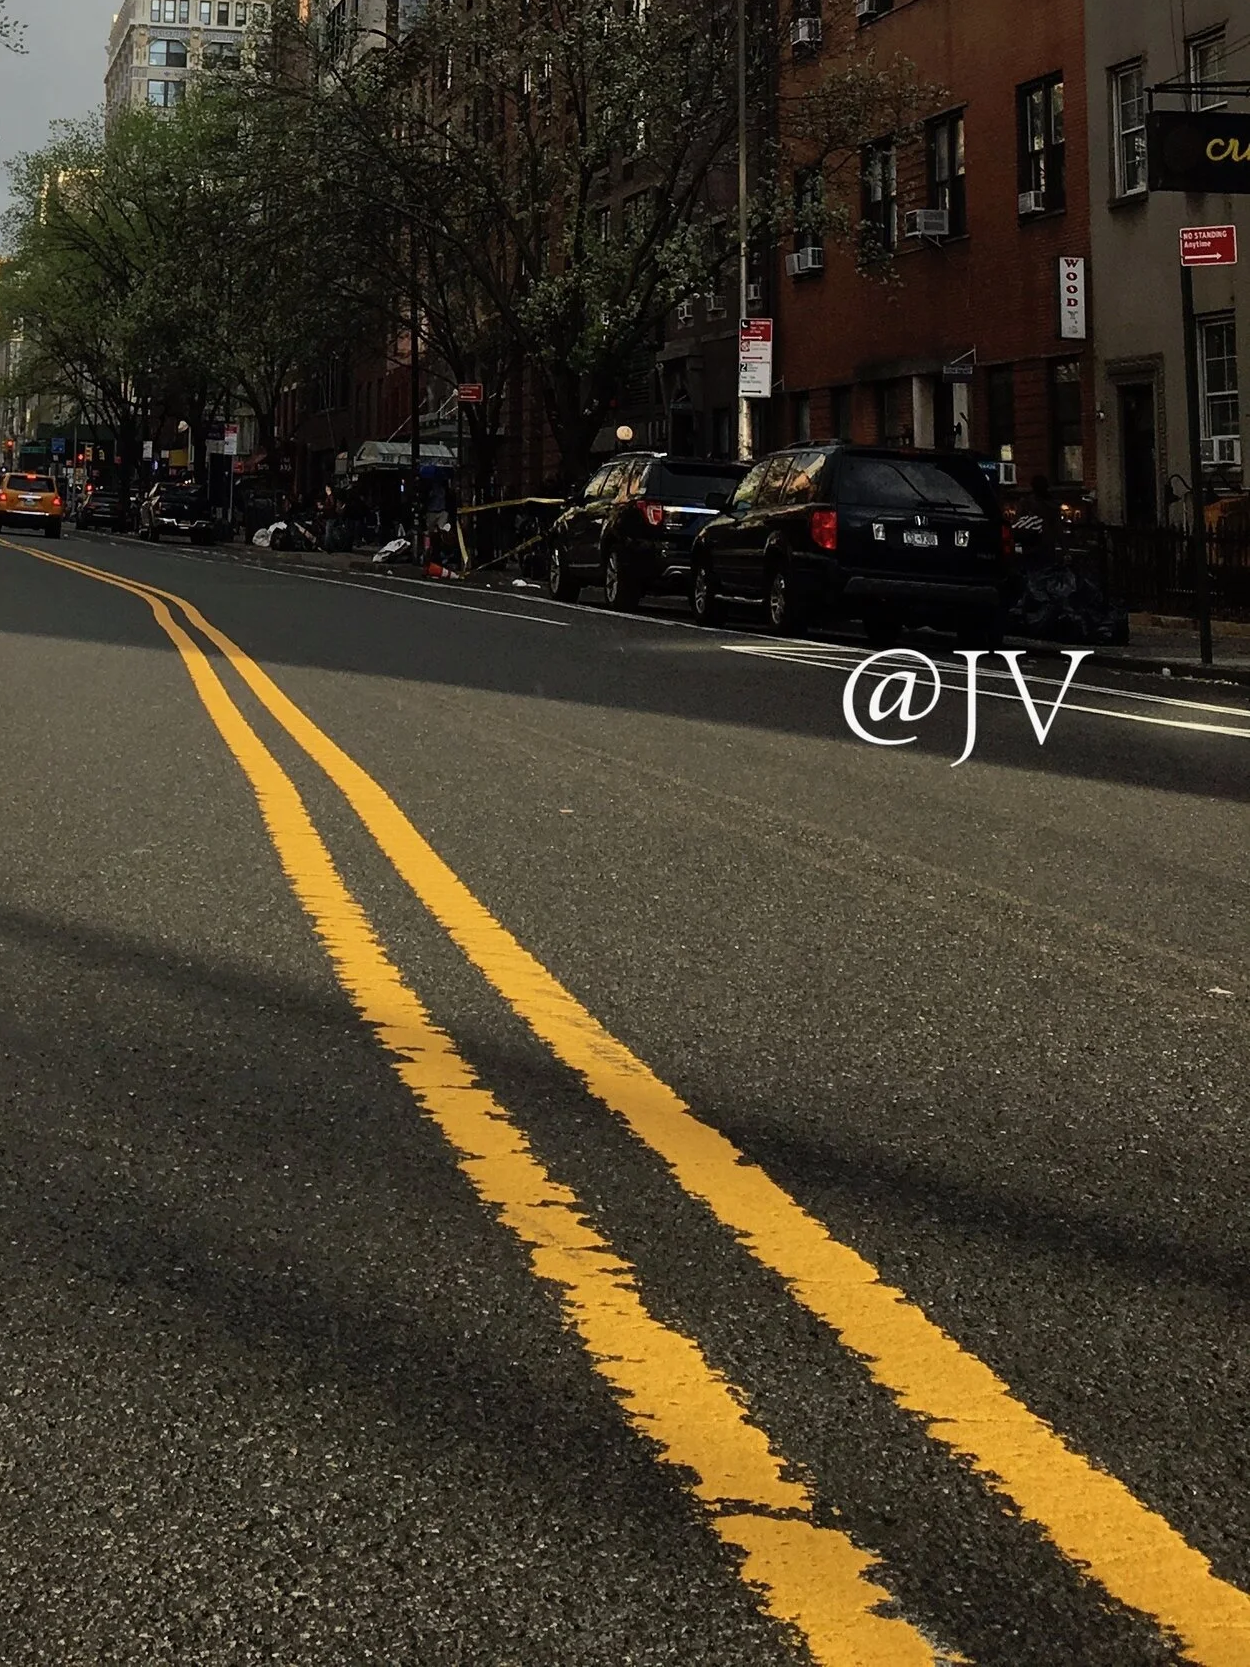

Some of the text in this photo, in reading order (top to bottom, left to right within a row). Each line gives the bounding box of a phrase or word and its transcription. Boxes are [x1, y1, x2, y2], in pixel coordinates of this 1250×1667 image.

[1183, 230, 1228, 240] NO STANDING
[1184, 240, 1212, 249] Anytime
